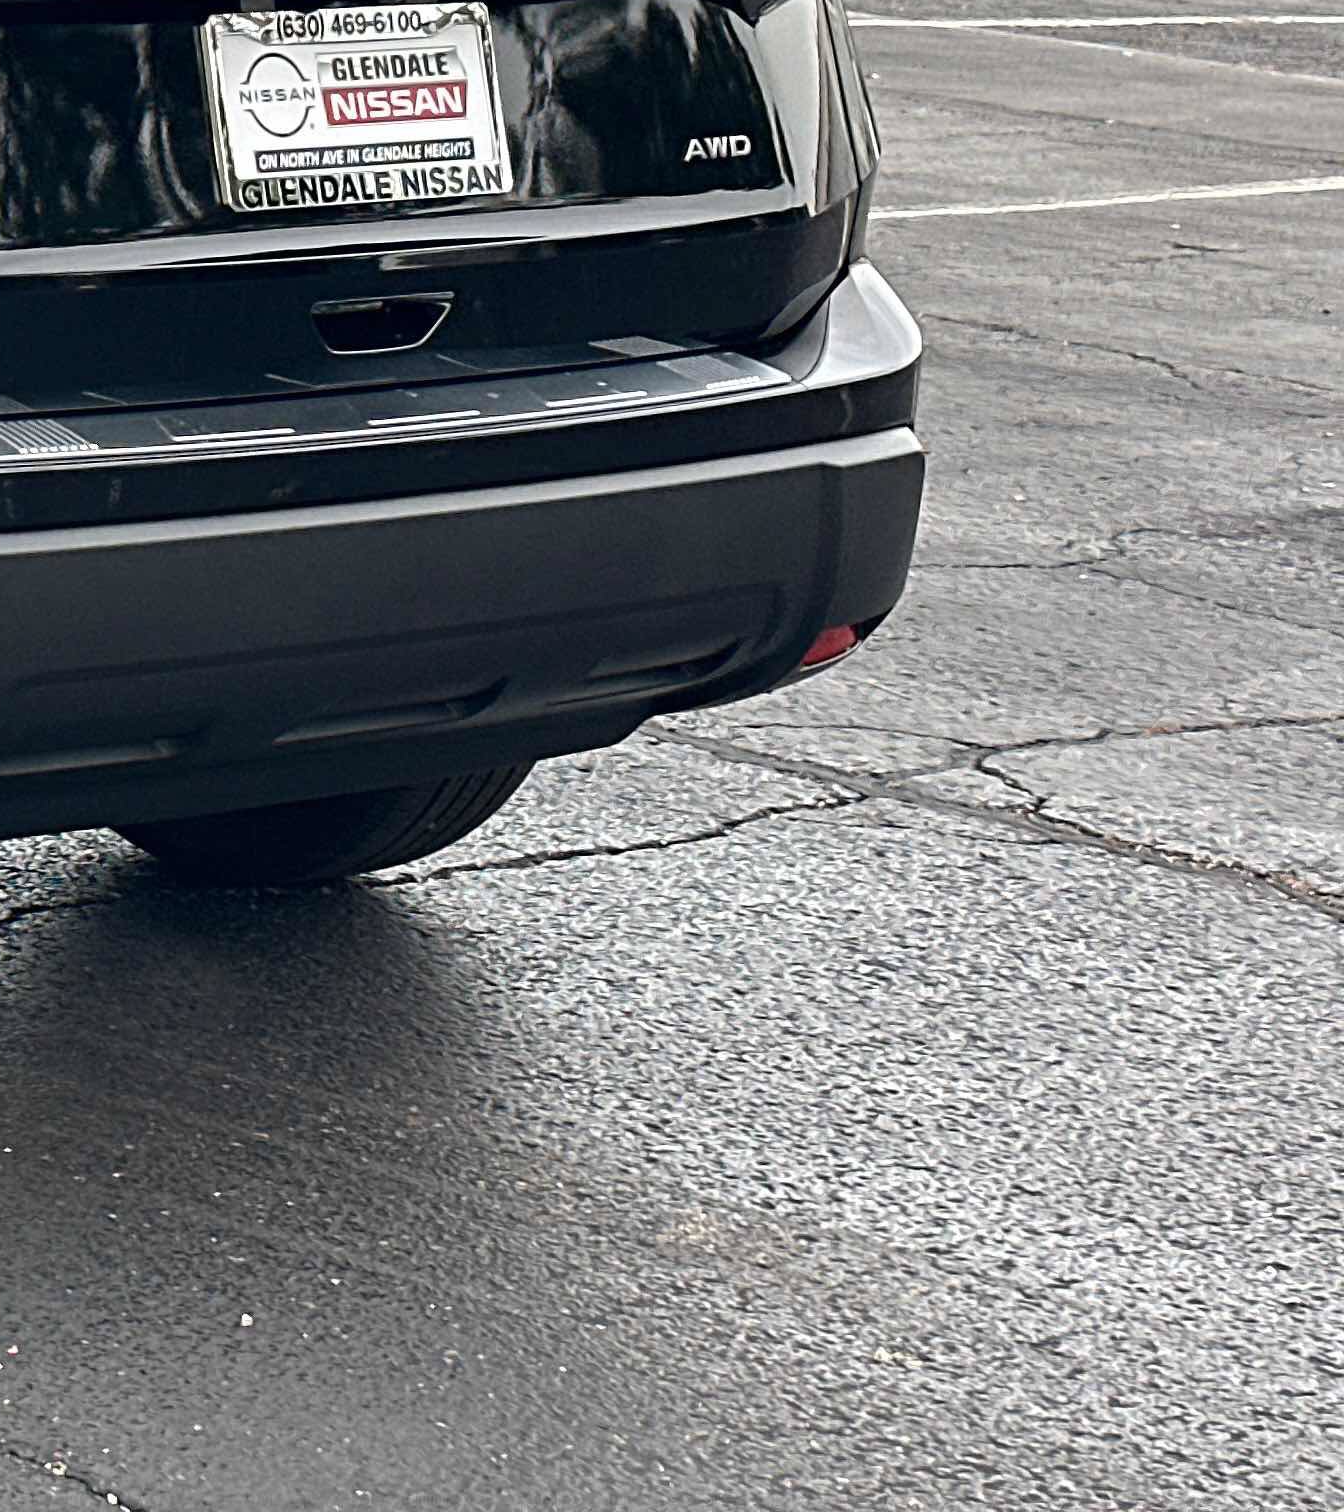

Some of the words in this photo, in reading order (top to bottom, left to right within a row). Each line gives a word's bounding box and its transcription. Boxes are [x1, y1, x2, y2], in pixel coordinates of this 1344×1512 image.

[277, 12, 325, 40] (630)
[331, 10, 422, 36] 469-6100
[331, 52, 449, 81] GLENDALE
[239, 87, 316, 105] NISSAN
[329, 86, 464, 120] NISSAN
[258, 154, 277, 170] ON
[280, 151, 319, 169] NORTH
[322, 149, 344, 165] AVE
[346, 147, 360, 164] IN
[362, 144, 422, 163] GLENDALE
[423, 140, 472, 159] HEIGHTS
[683, 135, 752, 163] AWD
[241, 171, 393, 209] GLENDALE
[399, 164, 504, 197] NISSAN
